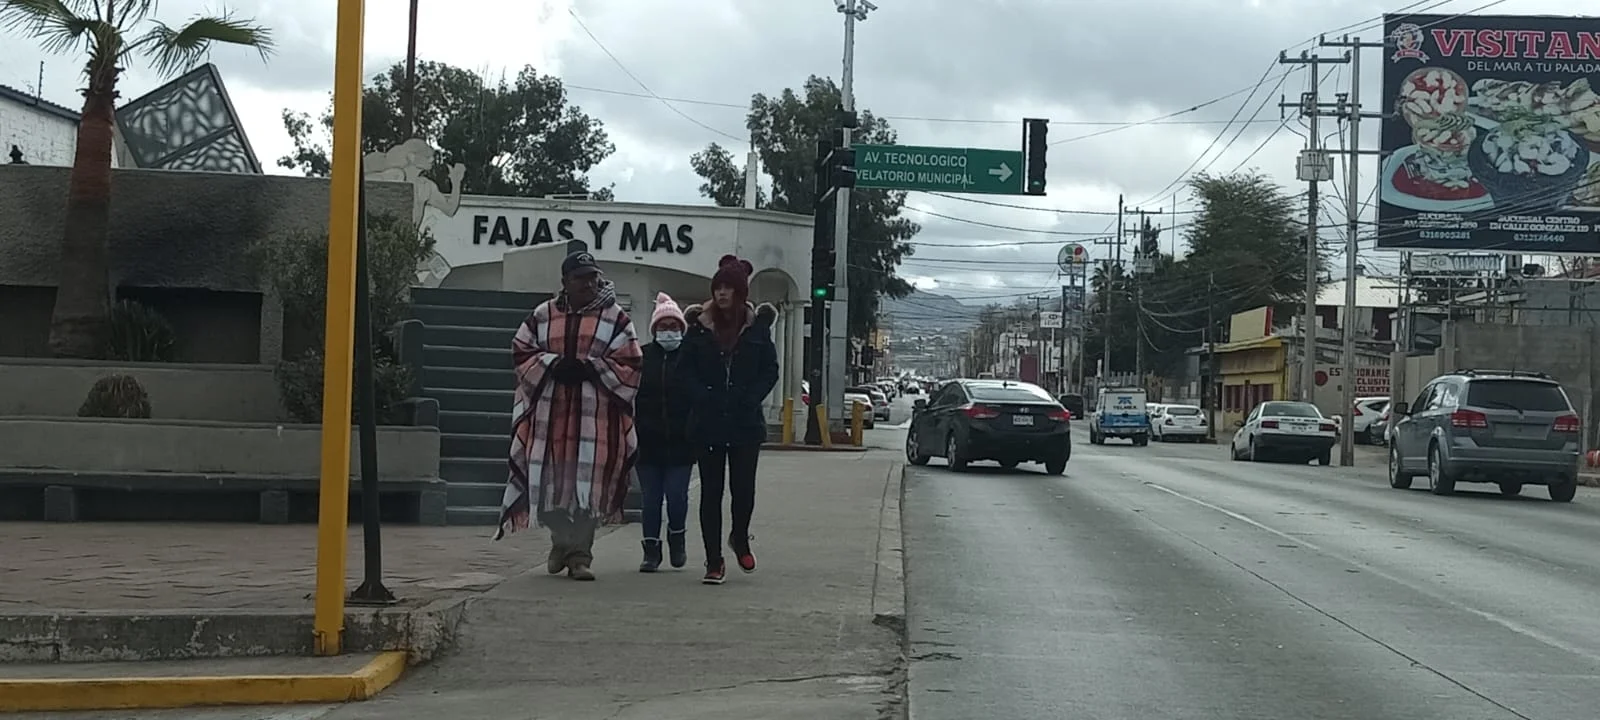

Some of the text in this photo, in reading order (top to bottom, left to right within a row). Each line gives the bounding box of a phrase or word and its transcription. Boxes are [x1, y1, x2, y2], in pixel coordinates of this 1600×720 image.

[1431, 28, 1600, 60] VISITAN
[1467, 60, 1600, 73] DEL MAR A TU PALADA
[864, 152, 968, 168] AV. TECNOLOGICO
[855, 169, 975, 185] VELATORIO MUNICIPAL
[1502, 223, 1529, 232] CALLE
[1529, 224, 1576, 232] GONZALEZ
[1545, 216, 1581, 225] CENTRO
[472, 215, 694, 254] FAJAS Y MAS
